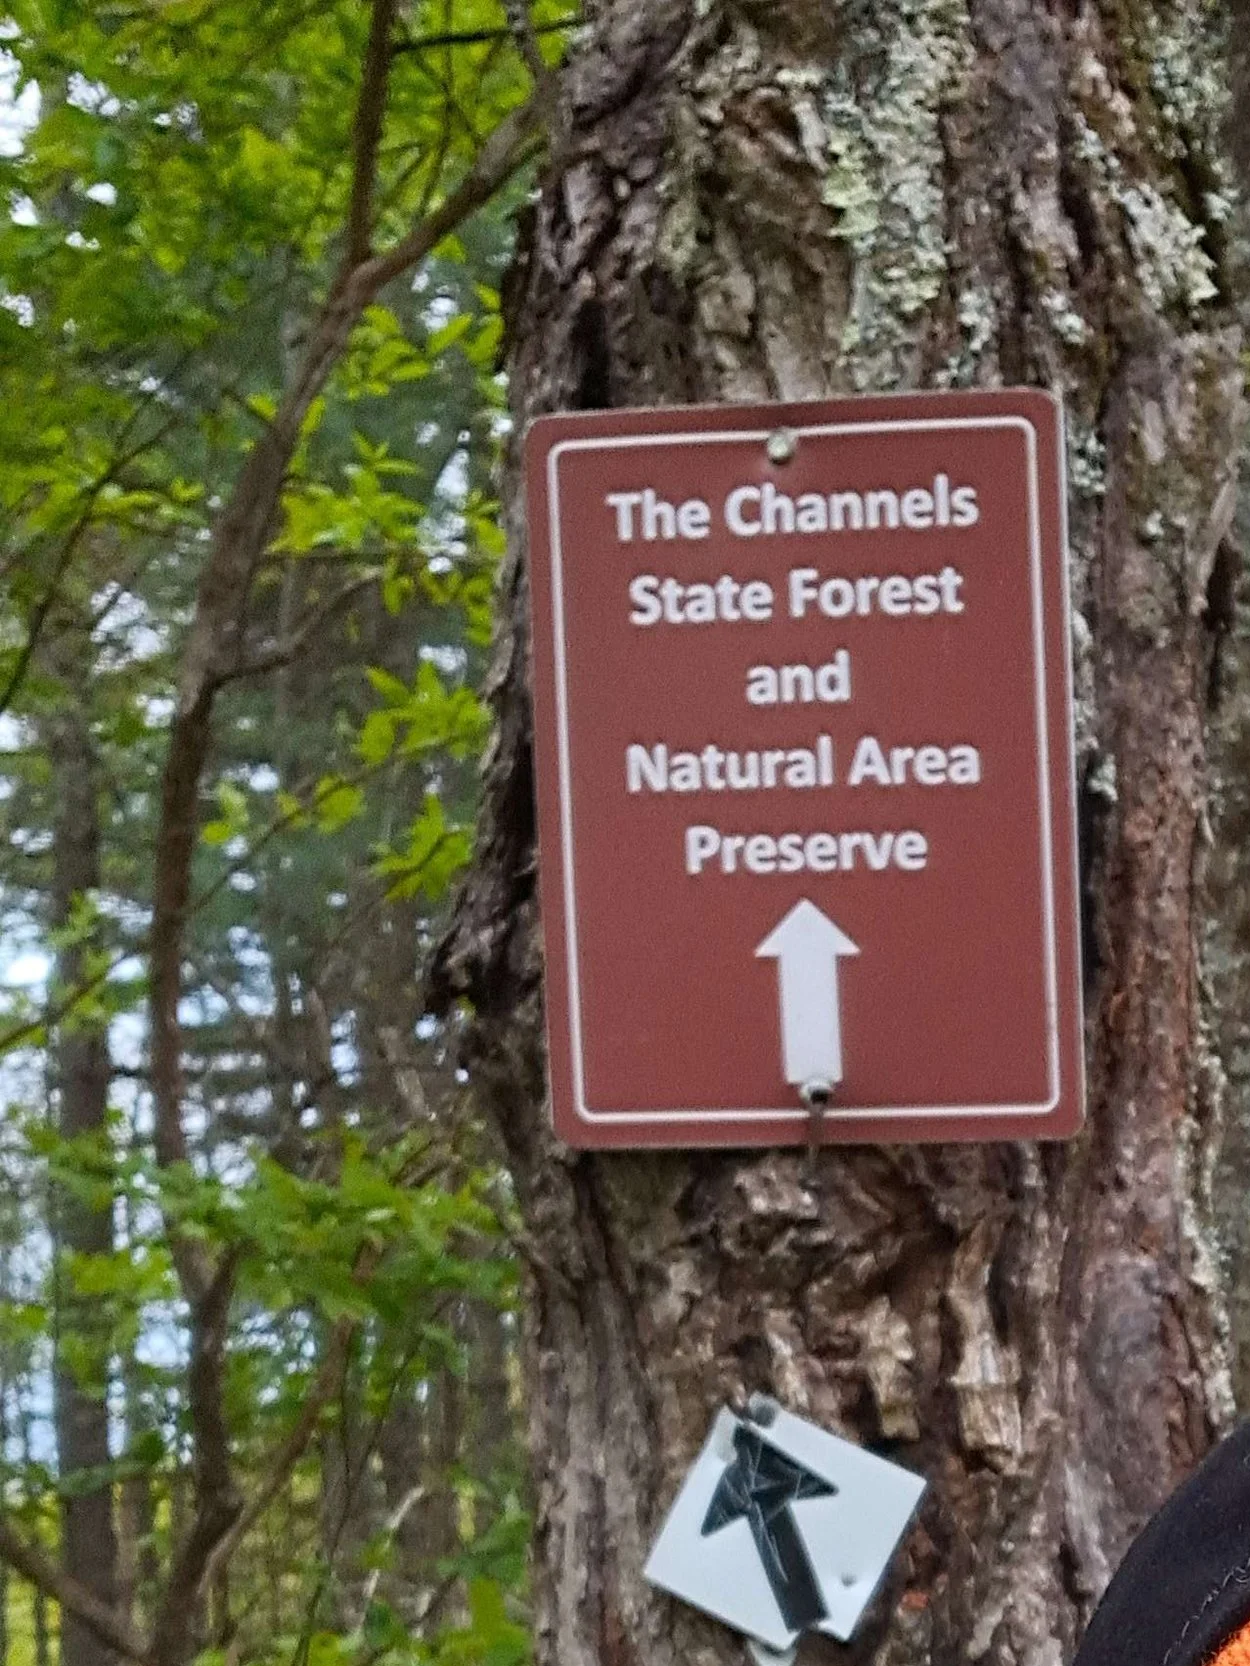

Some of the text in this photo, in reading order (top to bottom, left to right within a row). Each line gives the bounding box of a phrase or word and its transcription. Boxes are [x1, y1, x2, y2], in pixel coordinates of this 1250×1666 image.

[604, 473, 980, 542] The Channels
[628, 566, 965, 626] State Forest
[745, 649, 852, 705] and
[625, 735, 981, 793] Natural Area
[684, 825, 929, 875] Preserve
